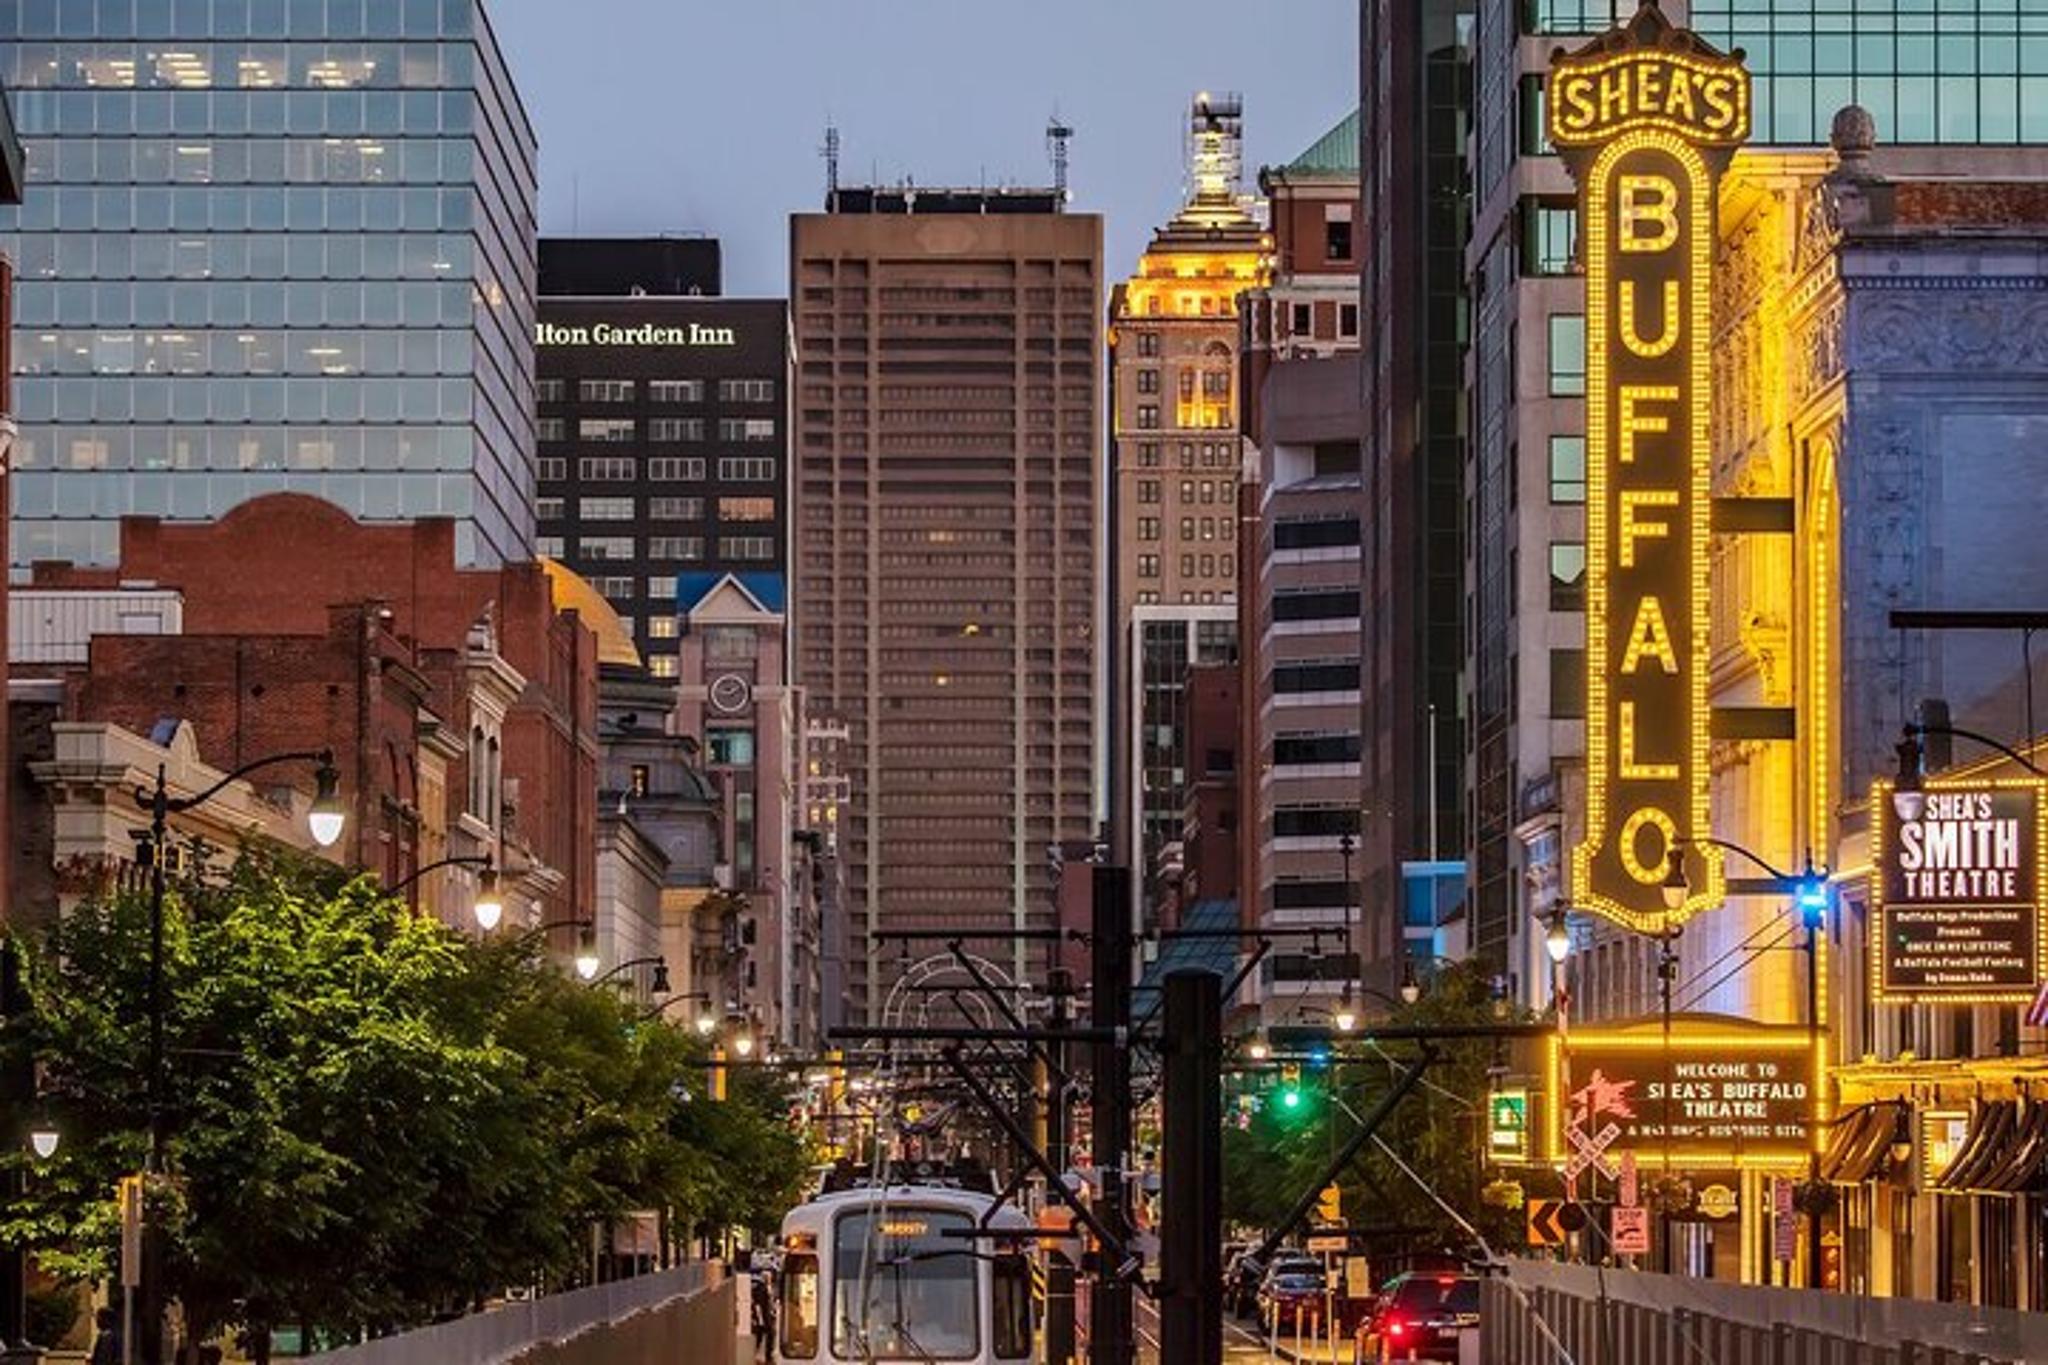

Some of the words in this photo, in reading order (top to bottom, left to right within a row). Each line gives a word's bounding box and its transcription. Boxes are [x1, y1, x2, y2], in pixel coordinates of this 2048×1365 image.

[1565, 65, 1733, 128] SHEA'S
[535, 324, 590, 345] lton
[593, 324, 684, 345] Garden
[690, 324, 735, 345] Inn
[1619, 175, 1679, 885] BUFFALO
[1927, 793, 1992, 820] SHEA'S
[1900, 820, 2018, 870] SMITH
[1904, 871, 2016, 897] THEATRE
[1675, 1063, 1750, 1078] WELCOME
[1757, 1063, 1778, 1078] TO
[1723, 1083, 1807, 1099] BUFFALO
[1685, 1101, 1767, 1118] THEATRE
[1627, 1125, 1637, 1136] A
